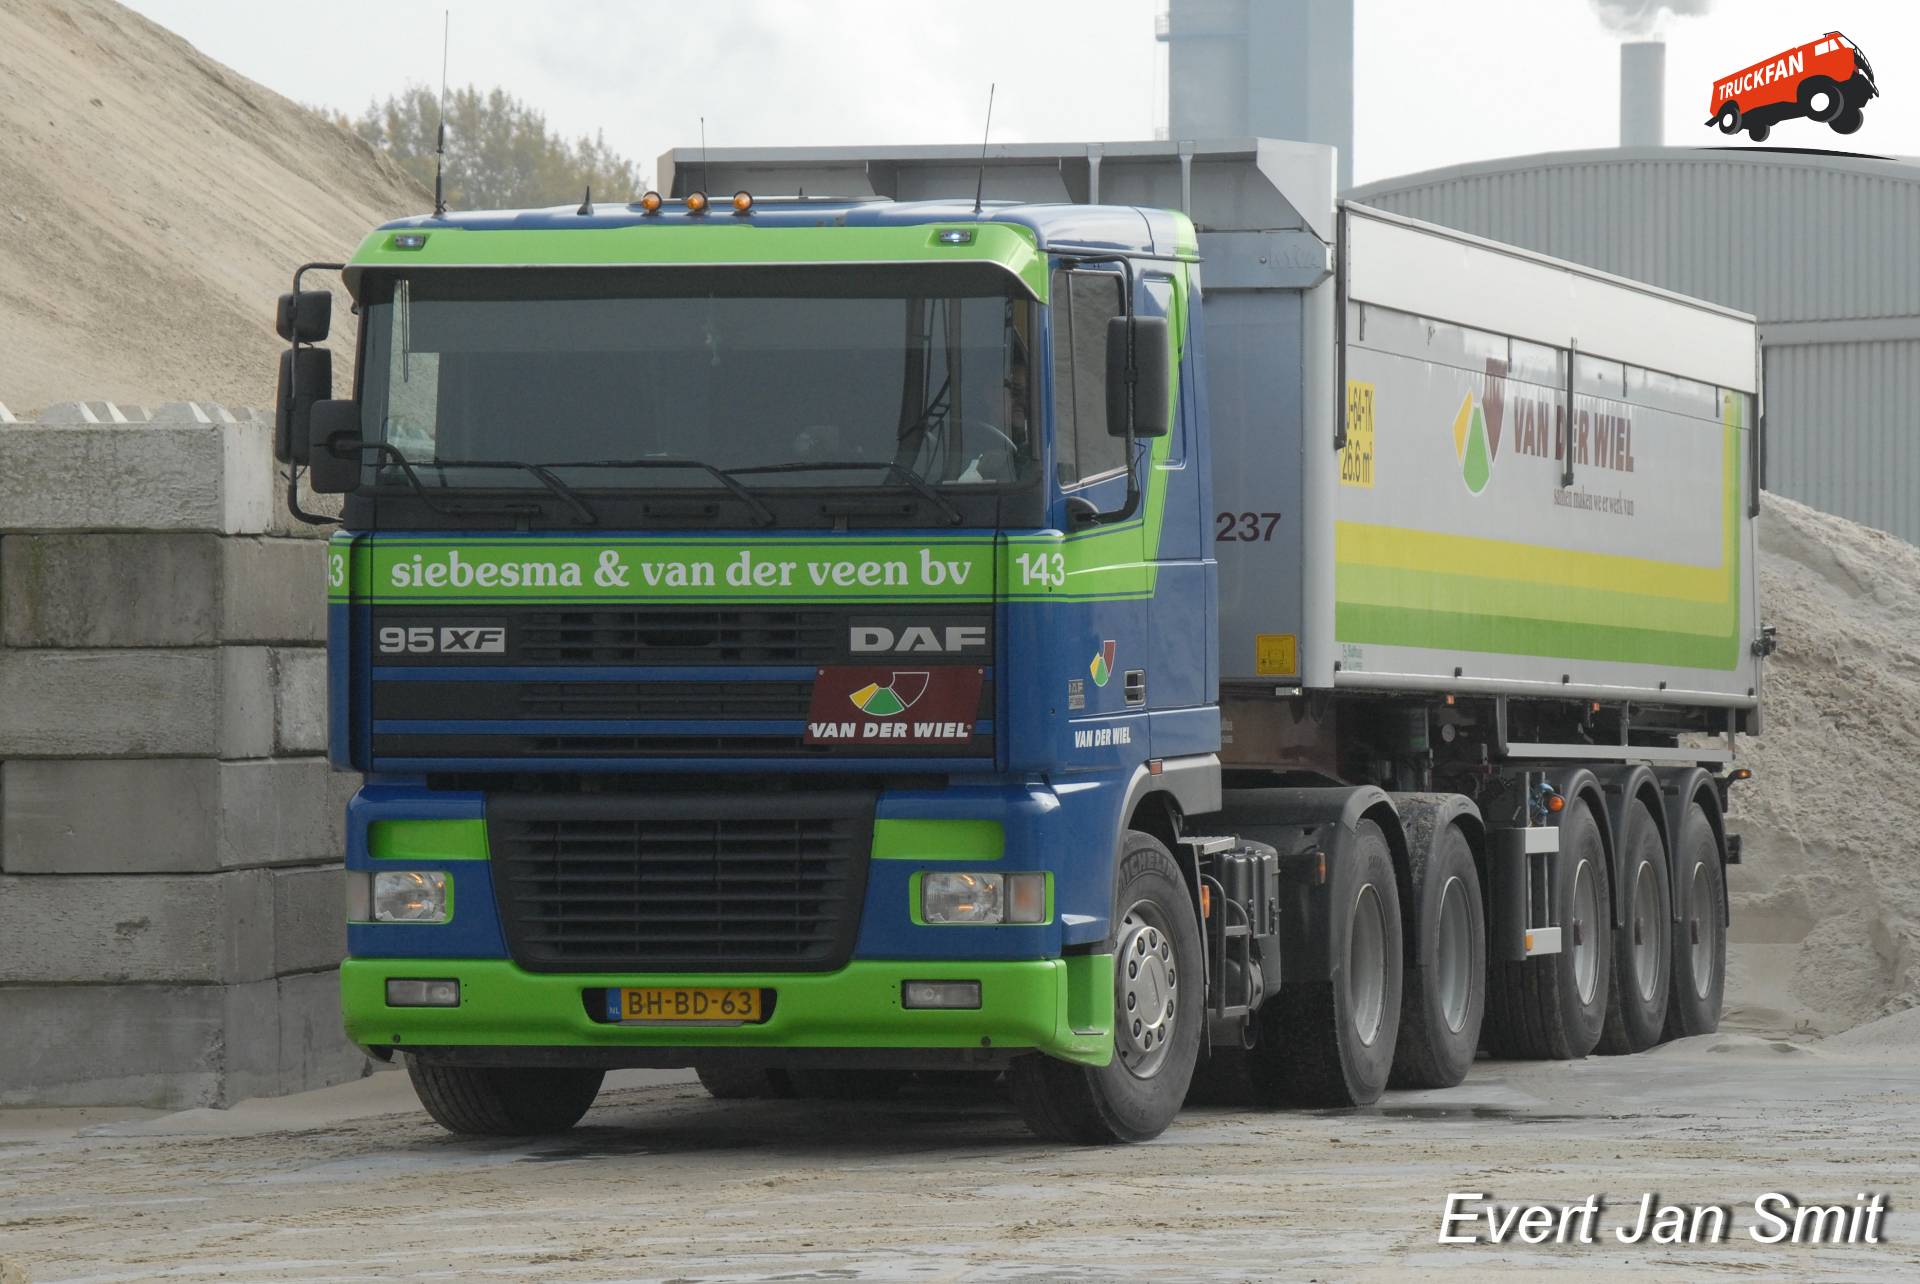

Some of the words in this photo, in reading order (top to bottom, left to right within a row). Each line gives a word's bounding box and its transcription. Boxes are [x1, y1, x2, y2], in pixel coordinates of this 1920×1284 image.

[1346, 386, 1374, 432] J-64-TK
[1514, 396, 1549, 458] VAN
[1594, 412, 1634, 473] WIEL
[1216, 512, 1281, 542] 237
[391, 550, 583, 588] siebesma
[593, 550, 630, 588] &
[641, 561, 715, 587] van
[725, 551, 797, 587] der
[807, 560, 909, 586] veen
[919, 548, 972, 586] bv
[1015, 552, 1065, 586] 143
[850, 627, 986, 652] DAF
[811, 722, 857, 738] VAN
[862, 722, 908, 738] DER
[913, 722, 969, 738] WIEL
[1075, 730, 1093, 748] VAN
[1094, 728, 1112, 747] DER
[1112, 726, 1132, 745] WIEL
[608, 1006, 621, 1015] NL
[628, 991, 753, 1016] BH-BD-63
